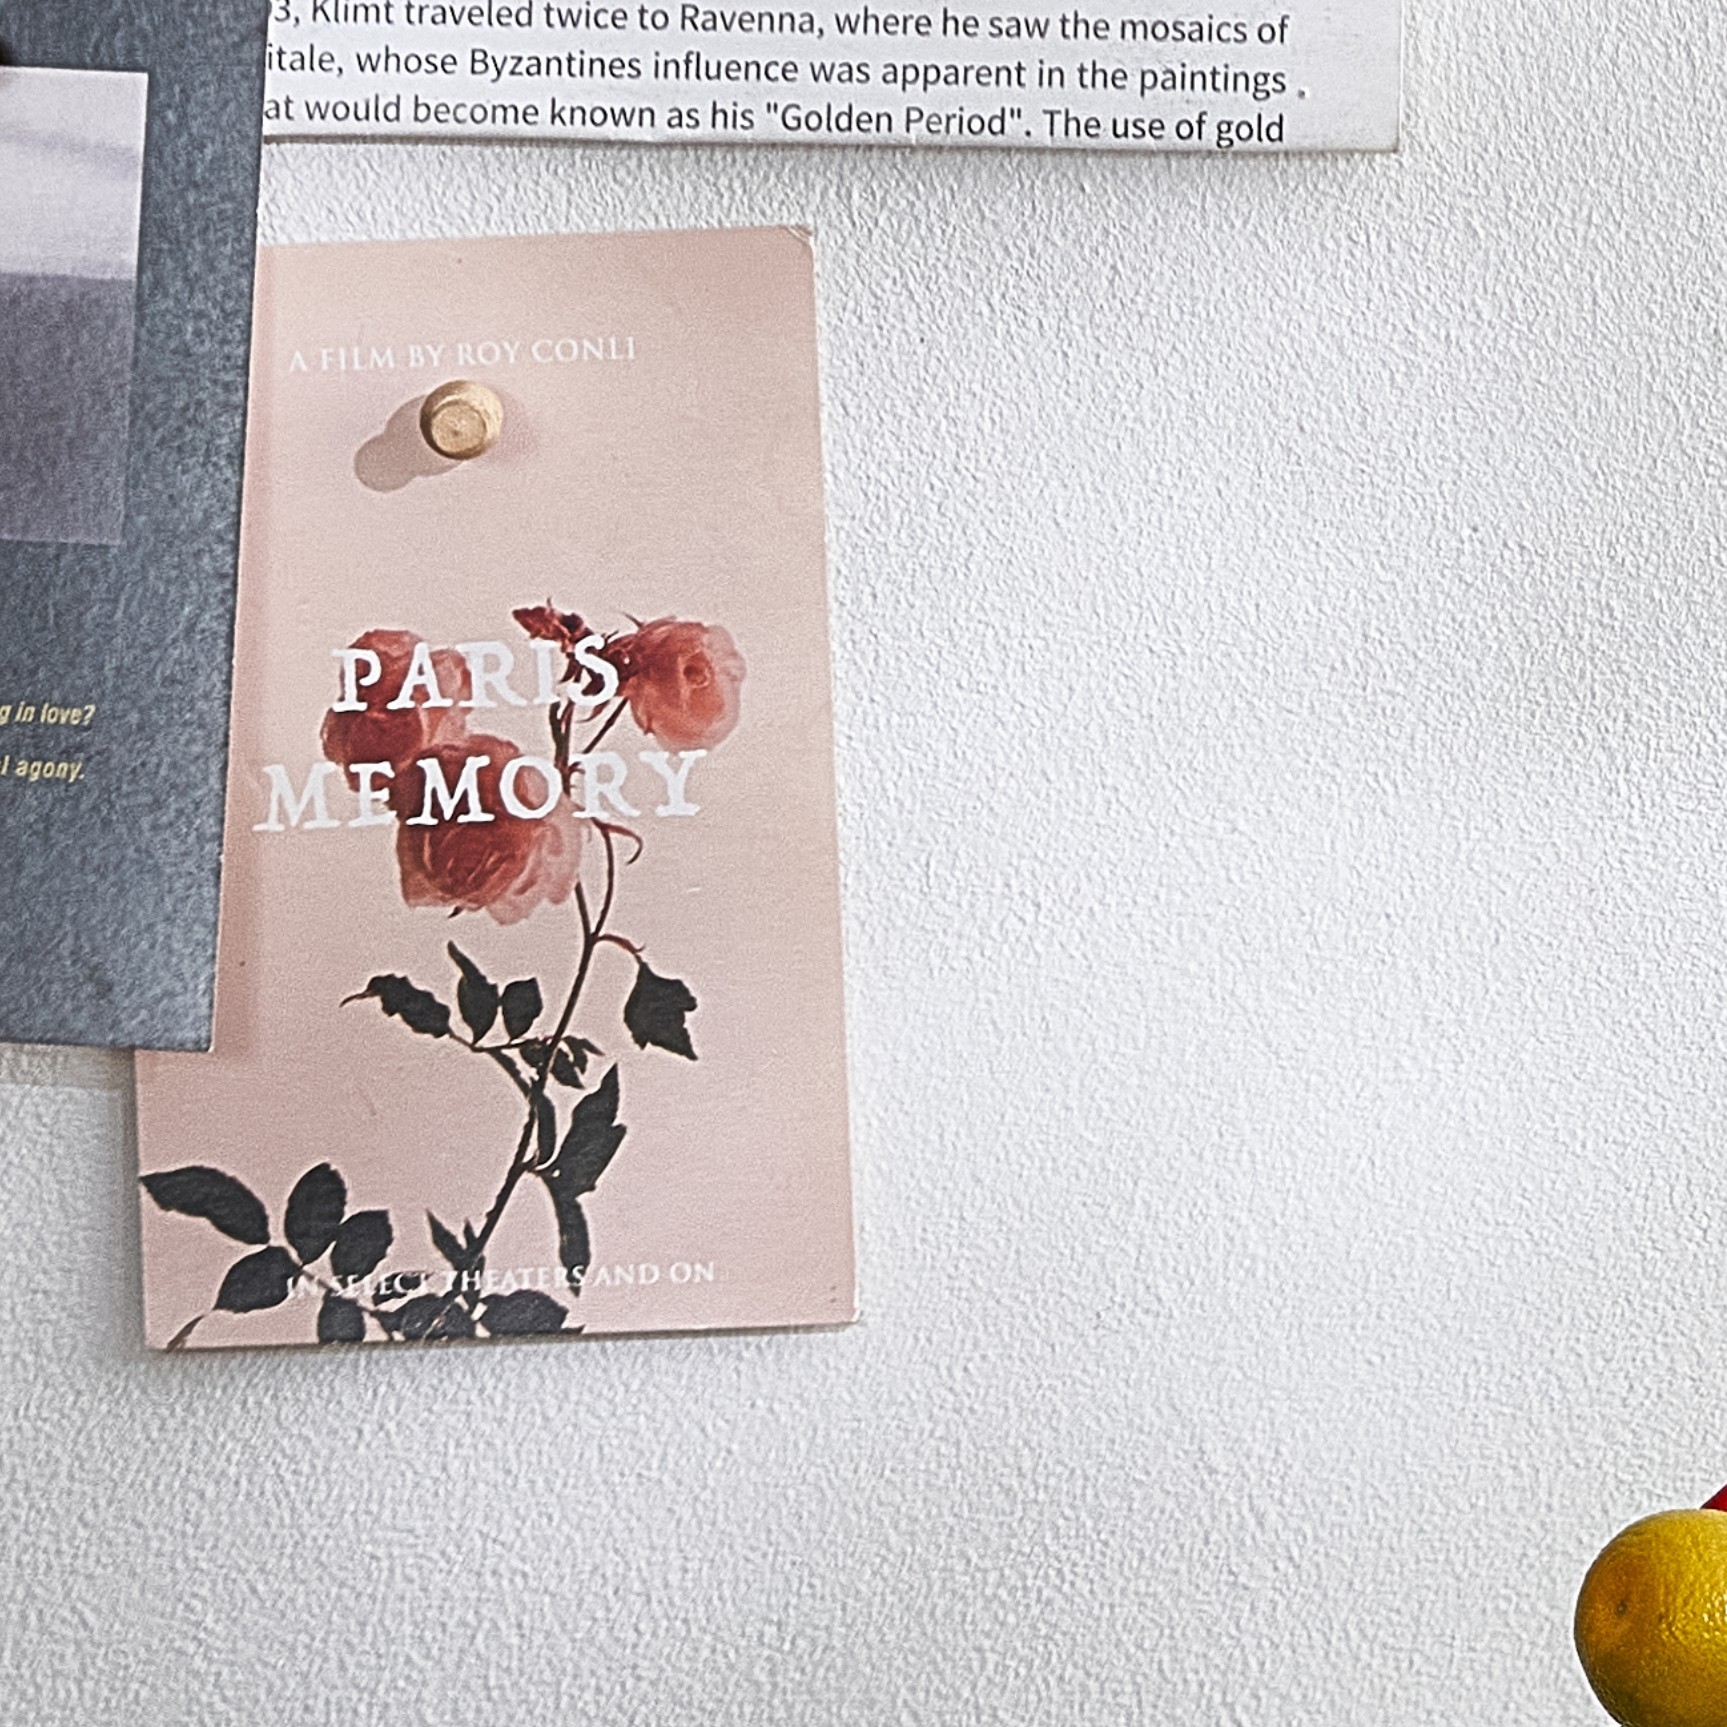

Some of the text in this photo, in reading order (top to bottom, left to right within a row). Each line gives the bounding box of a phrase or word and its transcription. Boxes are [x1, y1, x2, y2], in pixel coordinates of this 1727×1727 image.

[313, 0, 393, 24] Klimt
[405, 0, 532, 27] traveled
[544, 1, 628, 29] twice
[638, 5, 669, 30] to
[681, 4, 824, 38] Ravenna,
[835, 6, 932, 36] where
[943, 7, 979, 37] he
[989, 17, 1049, 39] saw
[1060, 10, 1109, 40] the
[1121, 14, 1247, 43] mosaics
[1258, 15, 1289, 44] of
[356, 45, 457, 74] whose
[471, 49, 641, 83] Byzantines
[654, 51, 798, 82] influence
[810, 62, 870, 84] was
[882, 61, 1026, 93] apparent
[1039, 59, 1064, 88] in
[1077, 60, 1127, 89] the
[1140, 62, 1286, 102] paintings
[305, 94, 400, 122] would
[414, 95, 538, 125] become
[551, 97, 654, 128] known
[667, 107, 699, 129] as
[712, 100, 754, 130] his
[767, 102, 892, 133] "Golden
[906, 106, 1031, 137] Period".
[1043, 108, 1101, 138] The
[1112, 118, 1165, 140] use
[1176, 111, 1207, 141] of
[1216, 113, 1283, 149] gold
[289, 350, 308, 373] A
[320, 346, 395, 371] FILM
[407, 343, 446, 369] BY
[456, 340, 521, 366] ROY
[331, 633, 620, 713] PARIS
[14, 701, 36, 723] in
[40, 702, 96, 726] love?
[15, 759, 85, 783] agony.
[252, 748, 708, 833] MEMORY
[442, 1265, 587, 1293] THEATERS
[588, 1263, 661, 1288] AND
[670, 1261, 716, 1284] ON
